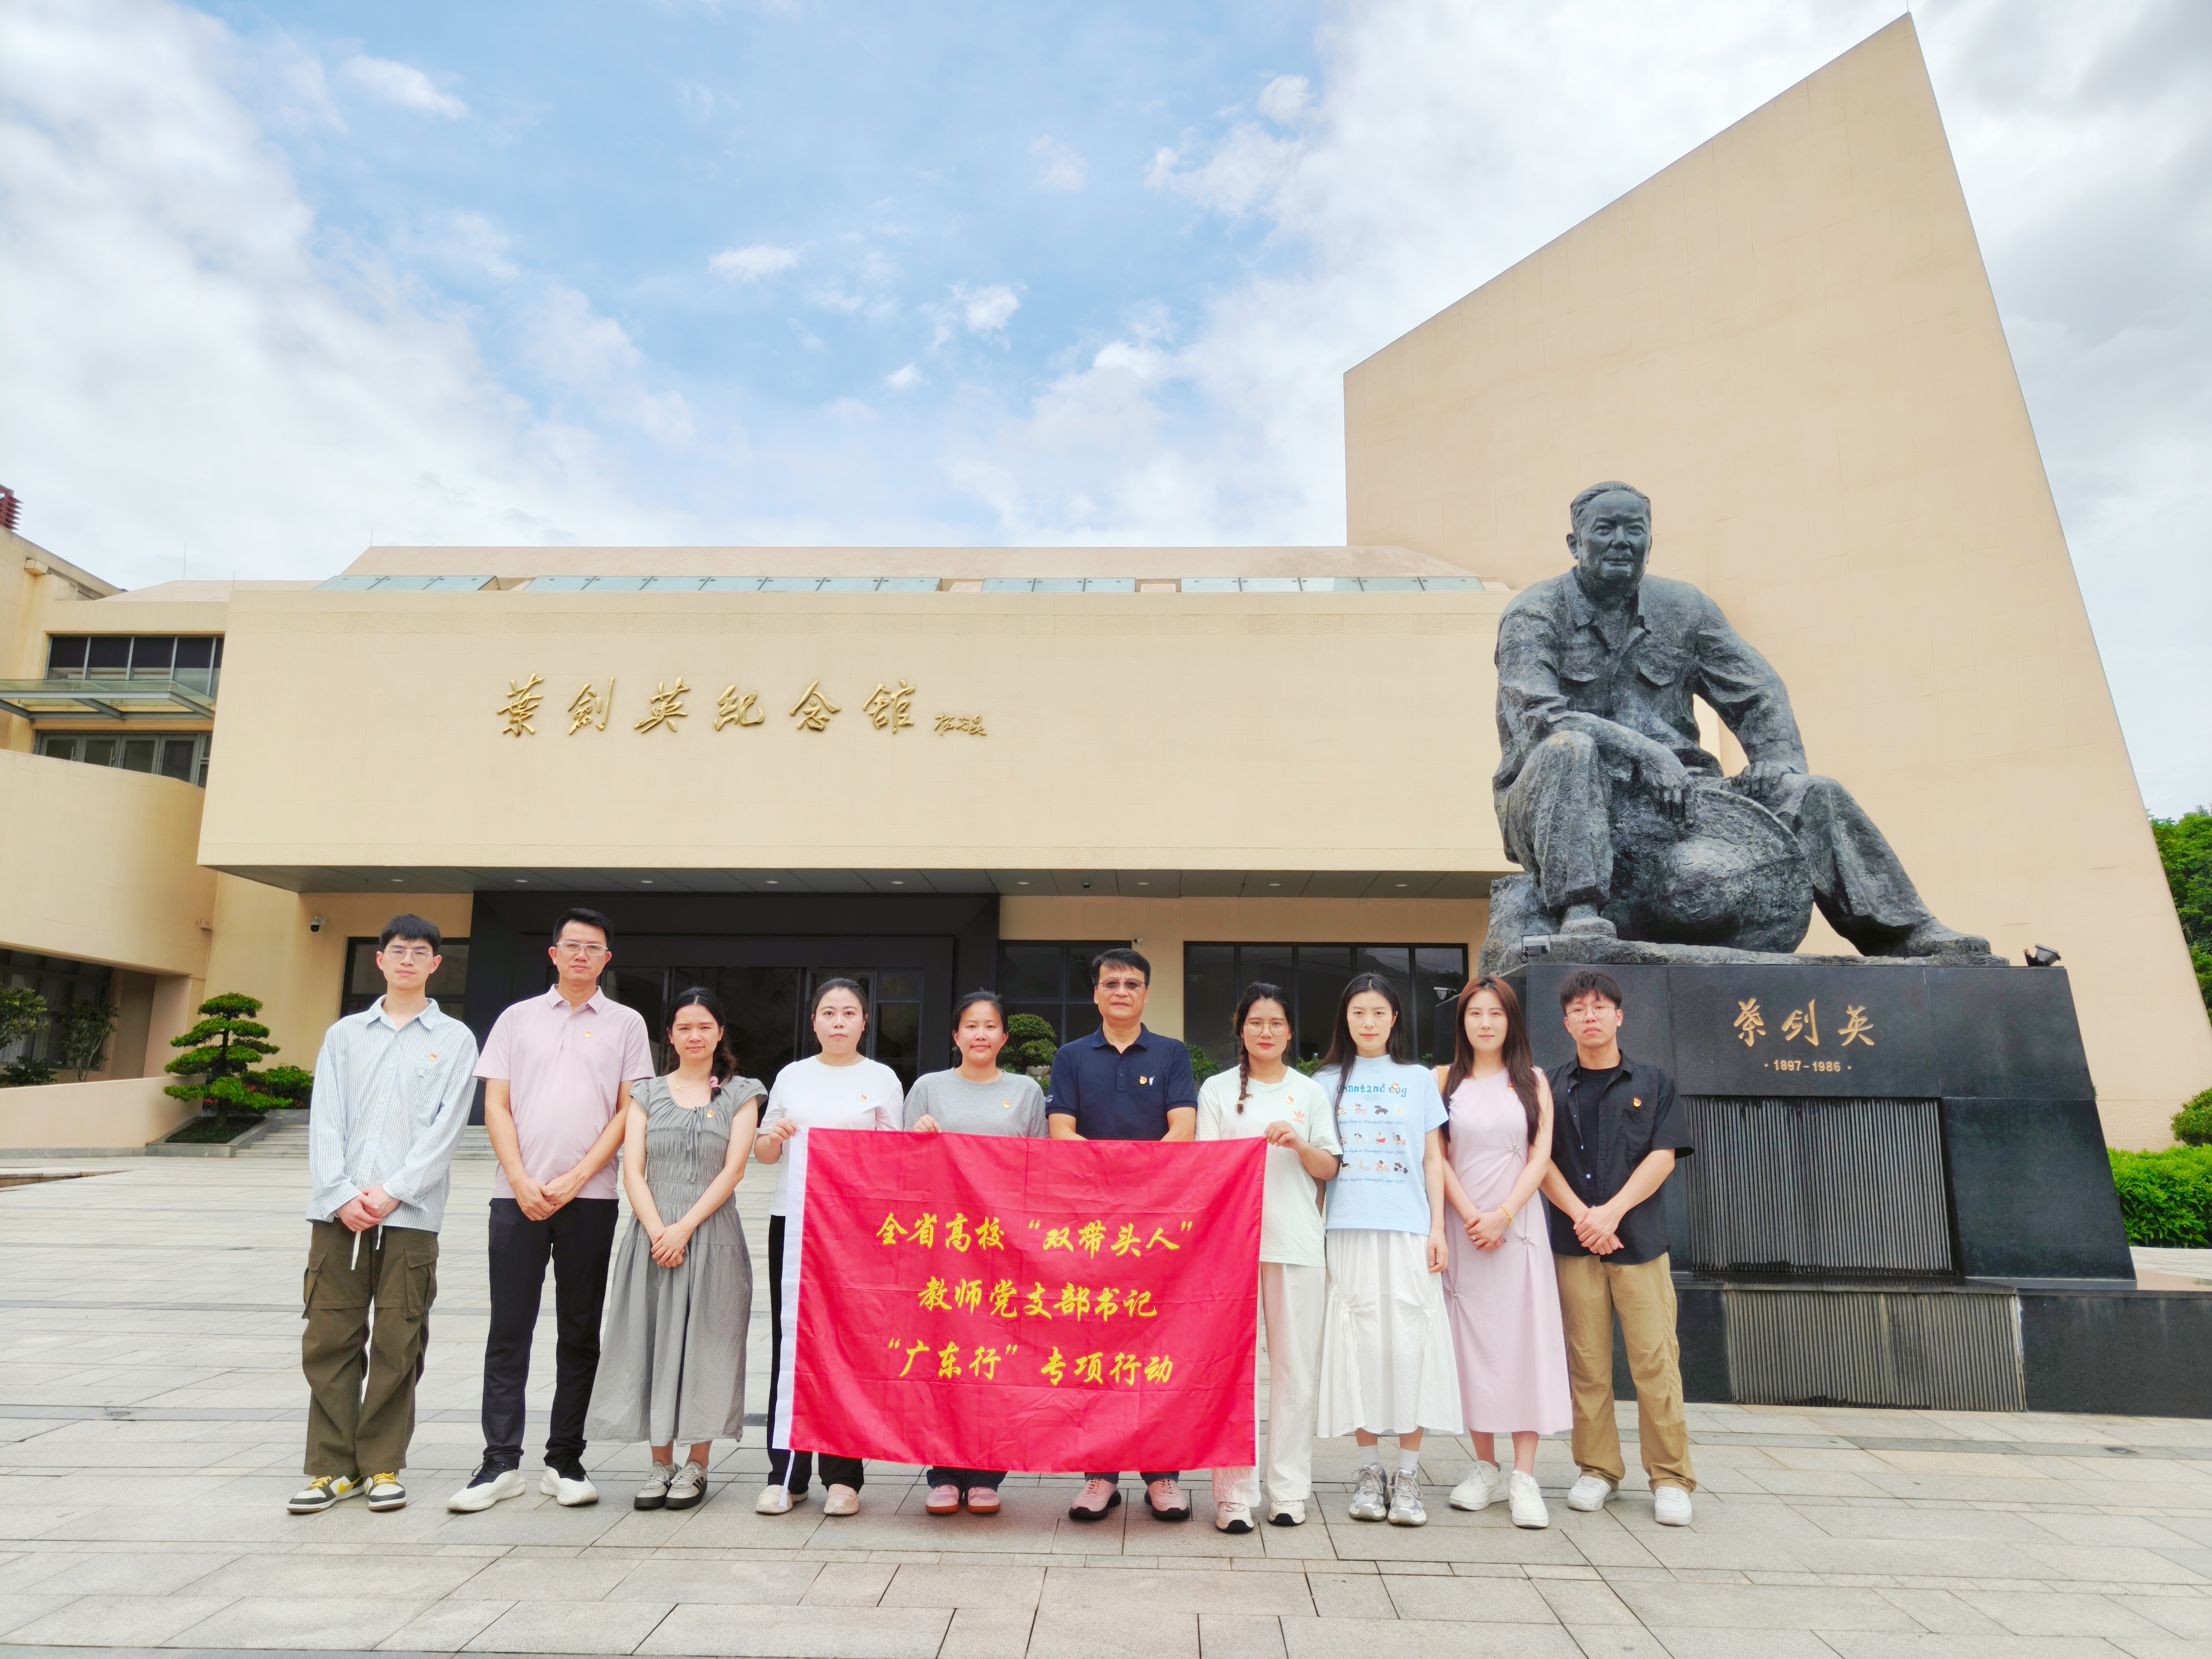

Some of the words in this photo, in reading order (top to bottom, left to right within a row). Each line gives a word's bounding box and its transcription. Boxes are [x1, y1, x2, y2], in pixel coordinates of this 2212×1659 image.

[1773, 1060, 1841, 1072] 1897-1986
[918, 1276, 1157, 1322] 教师党支部书记
